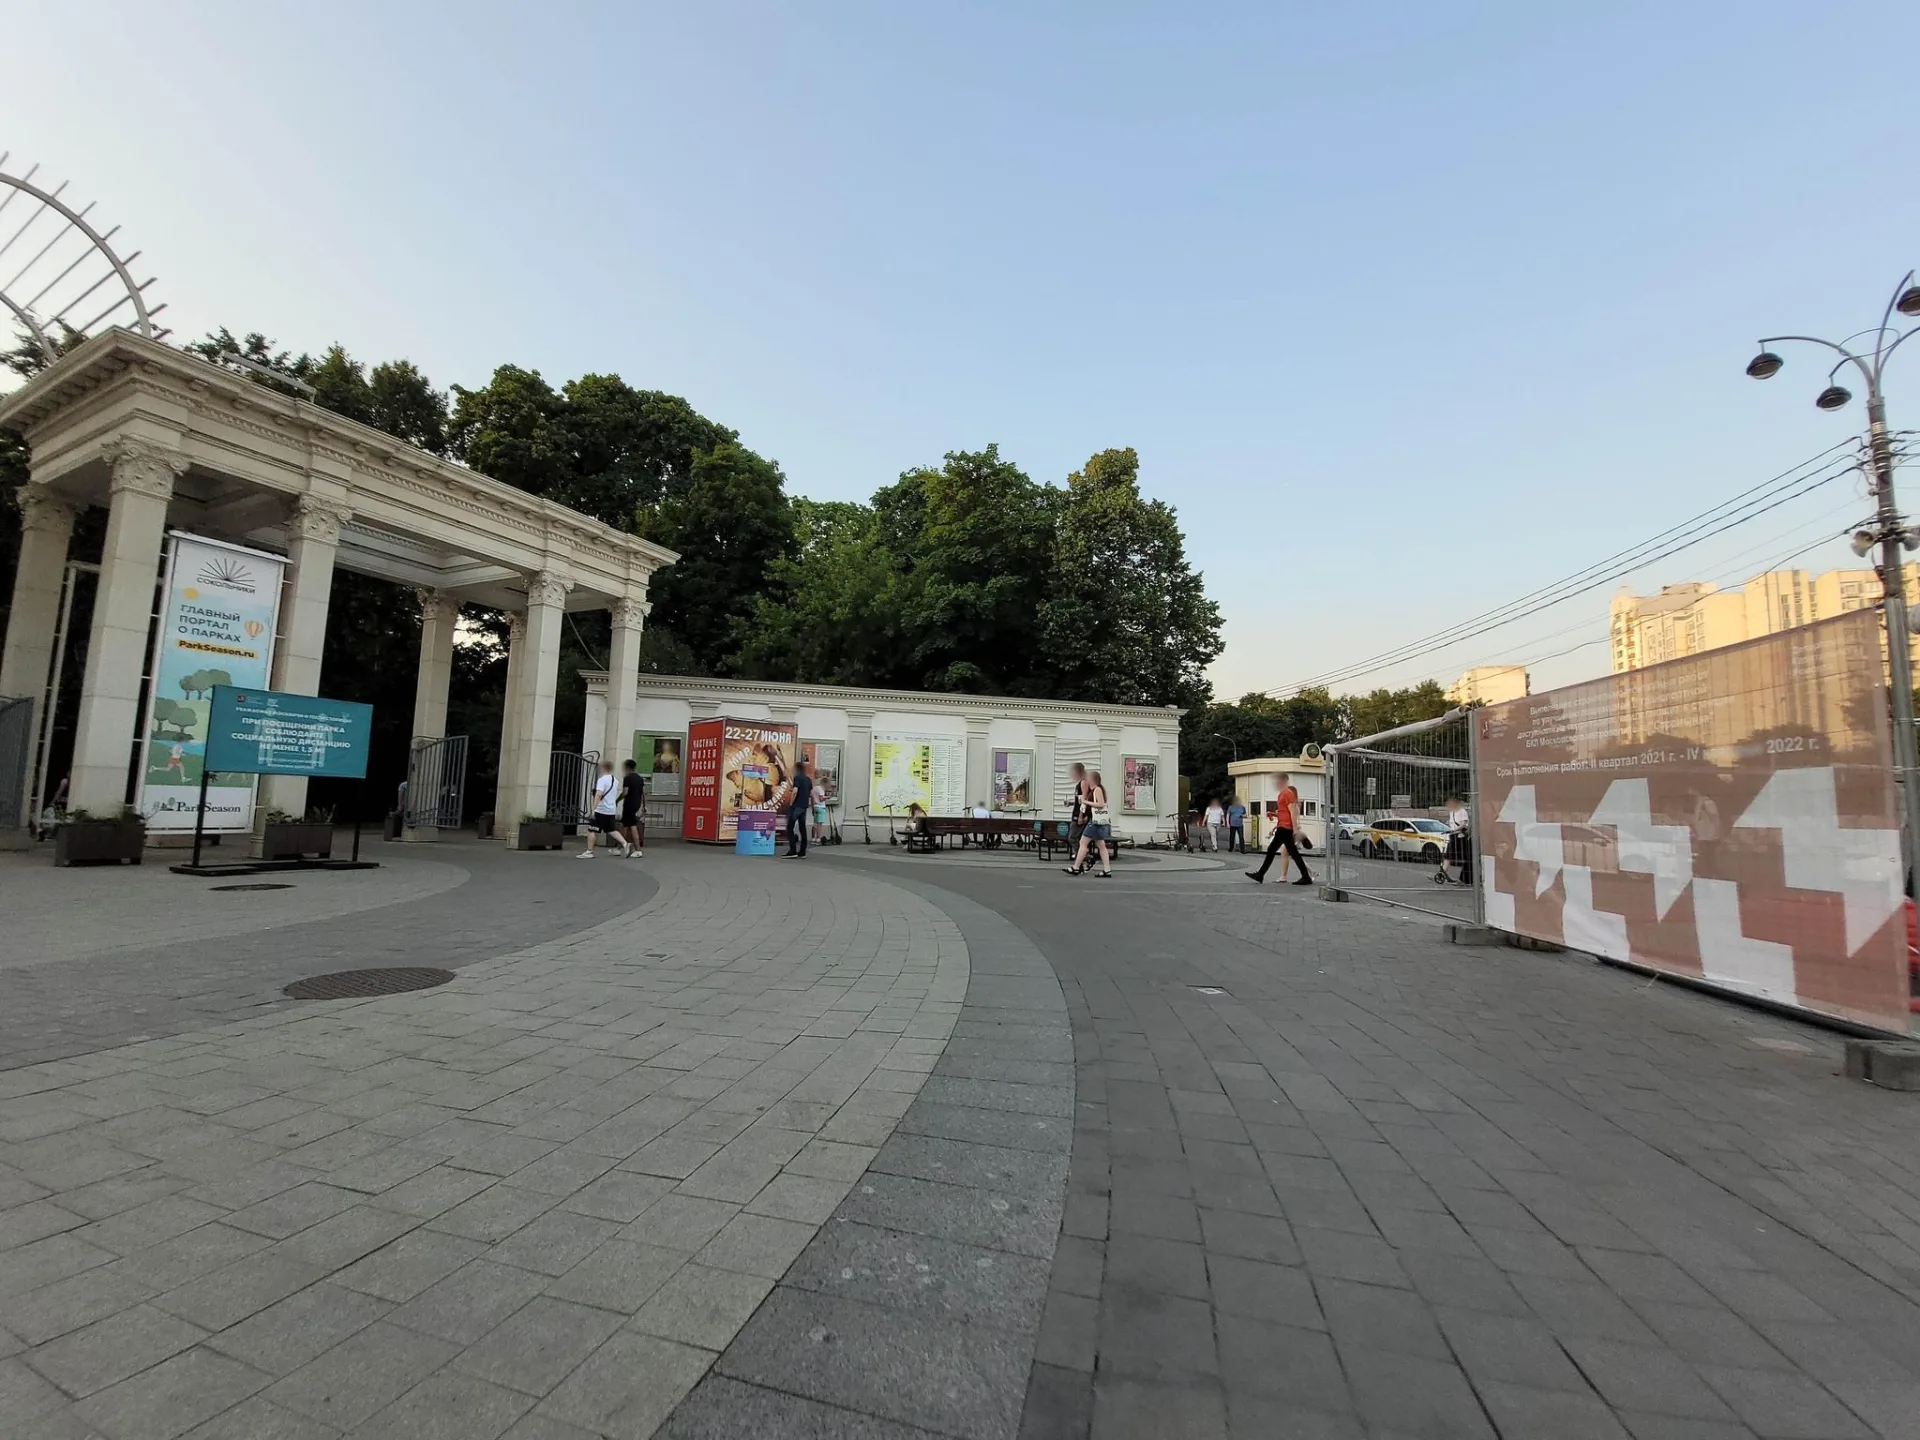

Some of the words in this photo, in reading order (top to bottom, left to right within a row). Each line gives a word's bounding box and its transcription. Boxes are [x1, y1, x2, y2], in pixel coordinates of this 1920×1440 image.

[196, 576, 256, 594] СОКОЛЬНИКИ
[181, 604, 240, 622] ГЛАВНЫЙ
[179, 615, 230, 631] ПОРТАЛ
[178, 625, 188, 634] О
[191, 627, 241, 643] ПАРКАХ
[178, 640, 255, 658] ParkSeason.ru
[231, 732, 297, 744] СОЦИАЛЬНУЮ
[297, 738, 351, 749] ДИСТАНЦИЮ
[265, 728, 324, 739] СОБЛЮДАЙТЕ
[725, 726, 760, 741] 22-27
[761, 730, 792, 744] ИЮНЯ
[693, 737, 717, 749] ЧАСТНЫЕ
[1766, 737, 1804, 754] 2022
[691, 760, 716, 770] РОССИИ
[729, 746, 751, 767] МИР
[1496, 767, 1512, 778] Срок
[1513, 763, 1559, 776] выполнения
[1598, 755, 1638, 771] квартал
[1640, 750, 1665, 765] 2021
[1687, 746, 1700, 761] IV
[689, 787, 714, 797] РОССИИ
